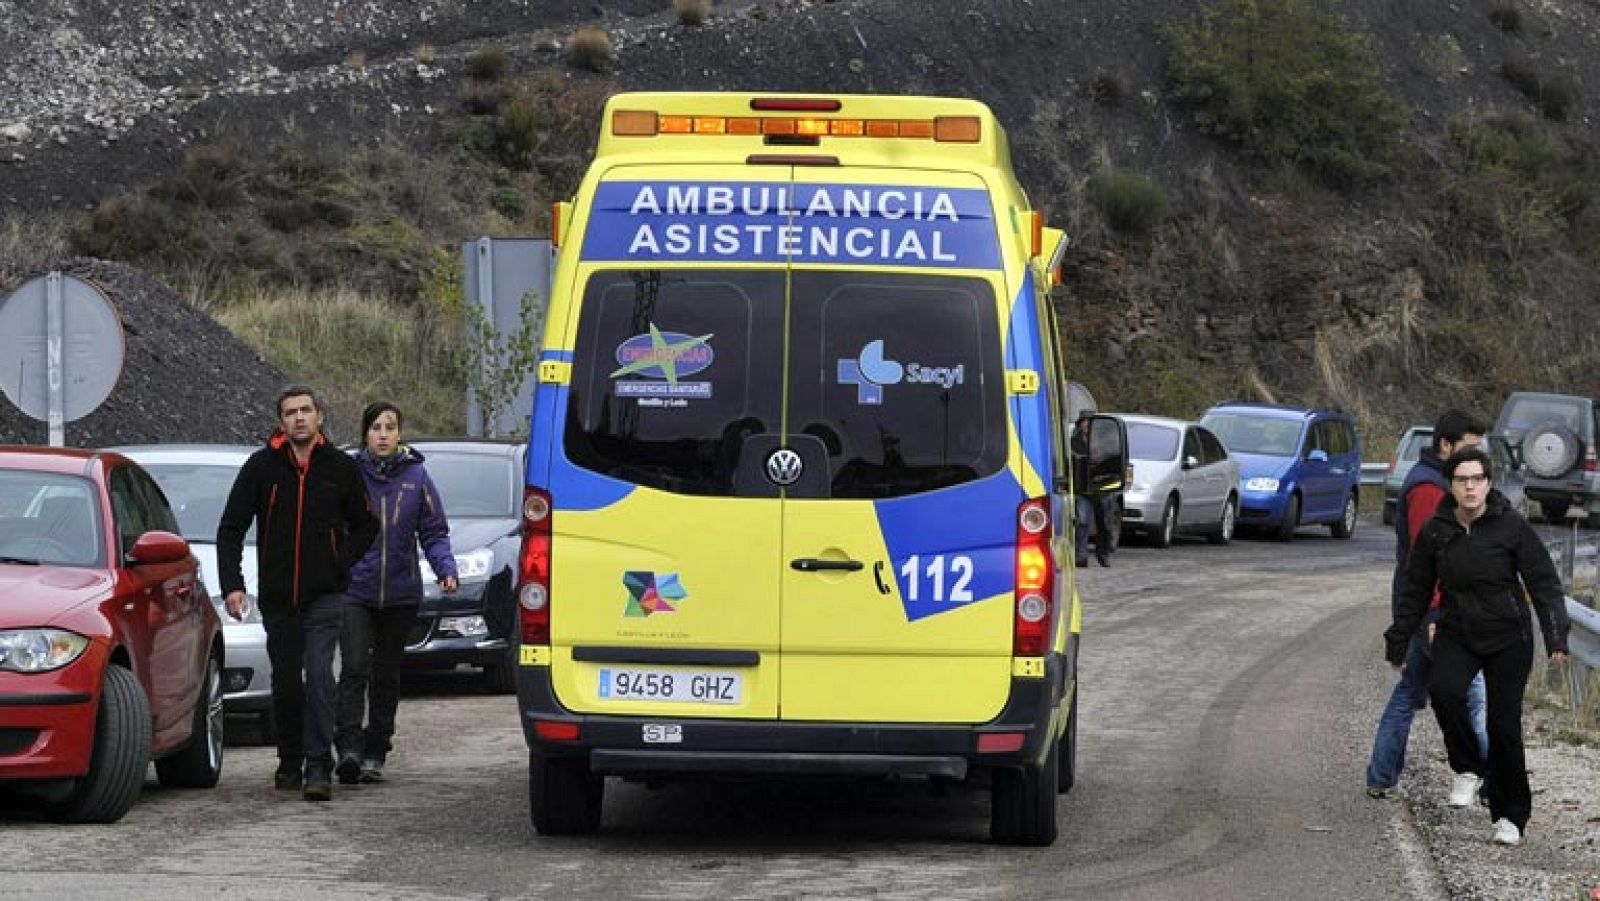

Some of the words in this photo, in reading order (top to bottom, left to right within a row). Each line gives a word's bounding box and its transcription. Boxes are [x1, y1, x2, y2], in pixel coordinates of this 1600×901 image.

[630, 185, 960, 223] AMBULANCIA
[628, 223, 957, 262] ASISTENCIAL
[906, 362, 964, 389] Sacyl
[901, 554, 974, 602] 112
[615, 672, 674, 697] 9458
[690, 674, 735, 699] GHZ
[646, 726, 679, 741] SP
